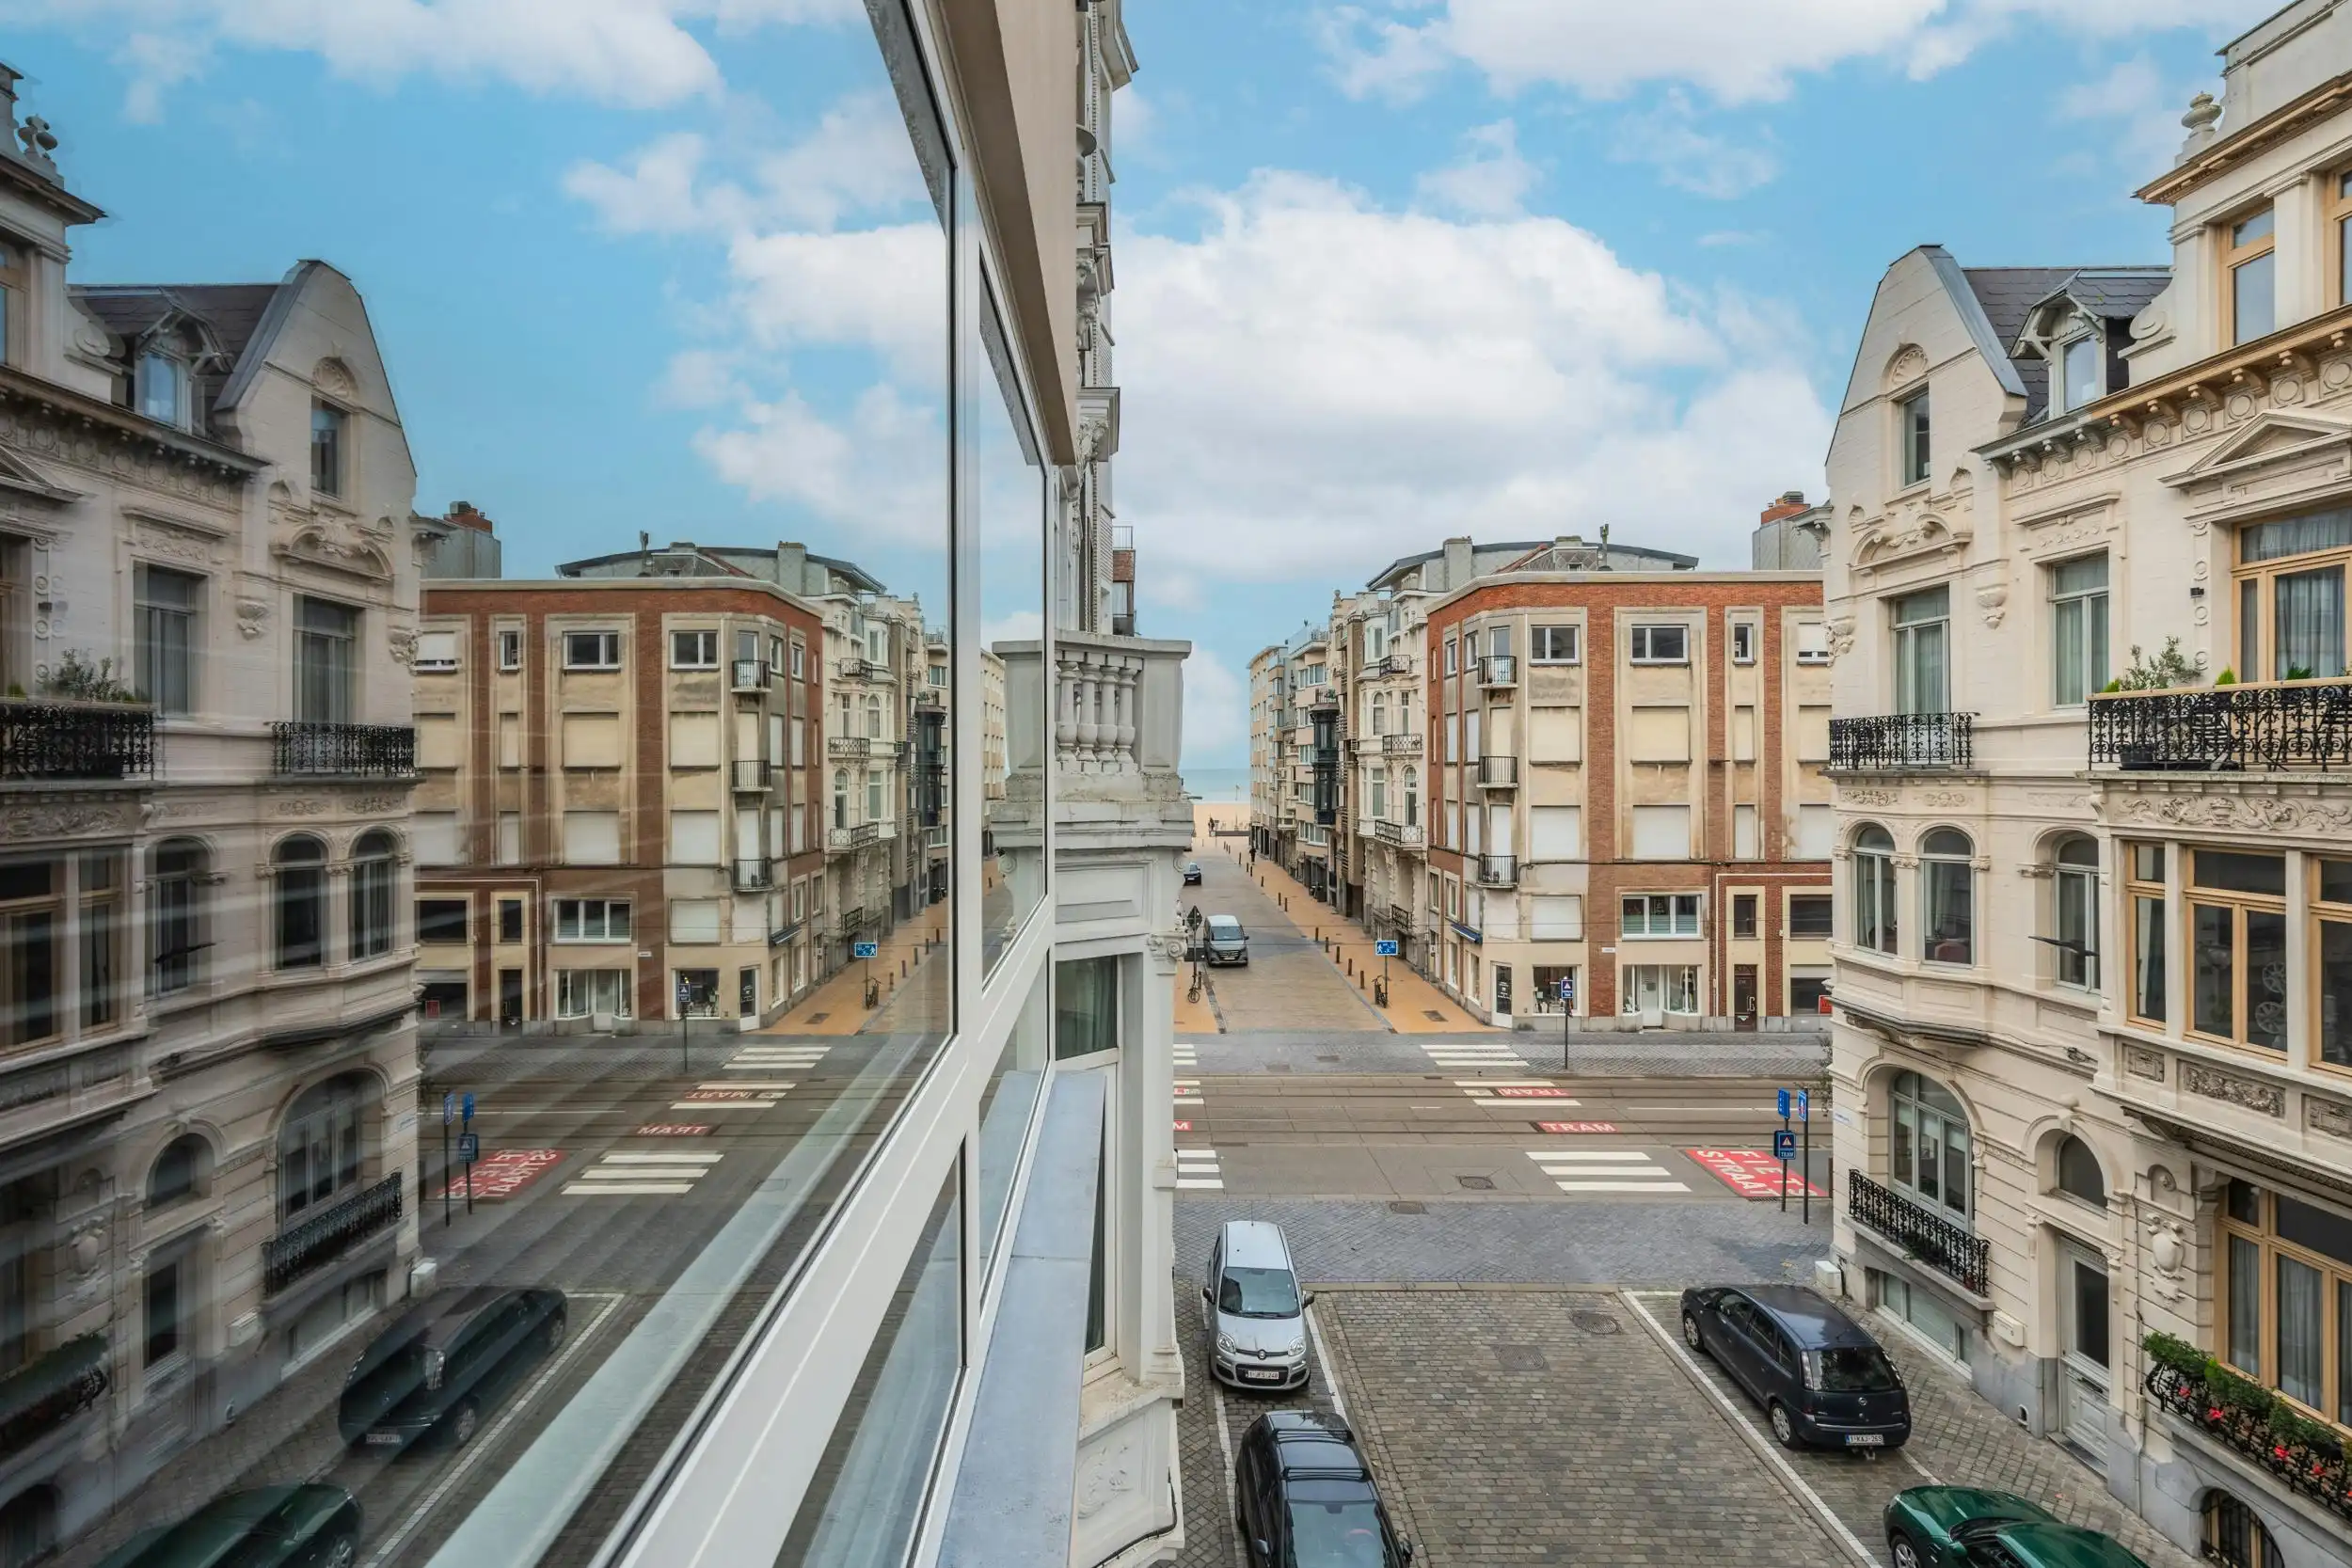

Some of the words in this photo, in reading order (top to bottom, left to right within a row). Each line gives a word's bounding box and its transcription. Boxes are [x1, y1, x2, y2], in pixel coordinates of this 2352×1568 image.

[1543, 1122, 1616, 1132] TRAM
[1697, 1150, 1780, 1196] STRAAT
[1729, 1150, 1818, 1196] FIETS
